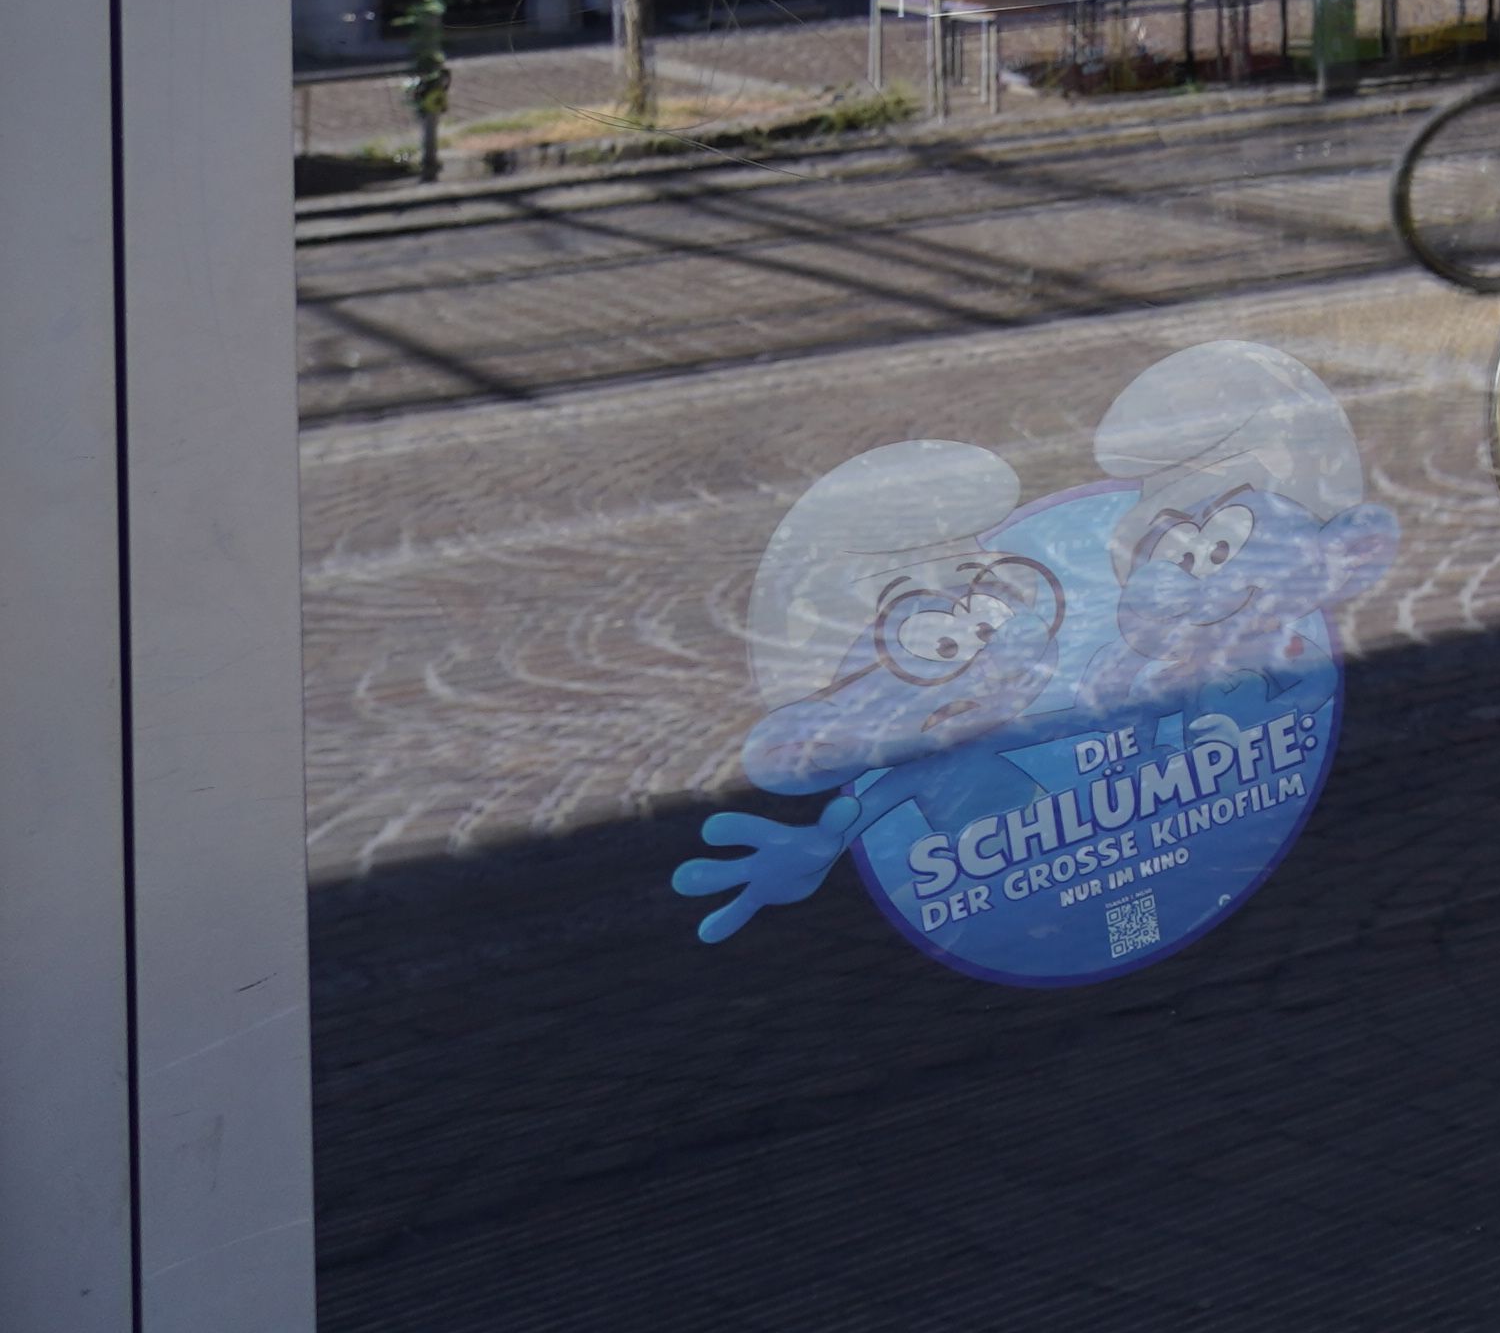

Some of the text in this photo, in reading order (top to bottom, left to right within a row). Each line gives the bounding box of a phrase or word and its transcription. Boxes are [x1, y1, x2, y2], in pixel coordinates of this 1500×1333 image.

[908, 709, 1317, 899] SCHLÜMPFE:
[1074, 725, 1139, 775] DIE
[920, 773, 1306, 933] DER GROSSE KINOFILM
[1059, 878, 1103, 907] NUR
[1108, 868, 1134, 890] IM
[1139, 847, 1190, 879] KINO
